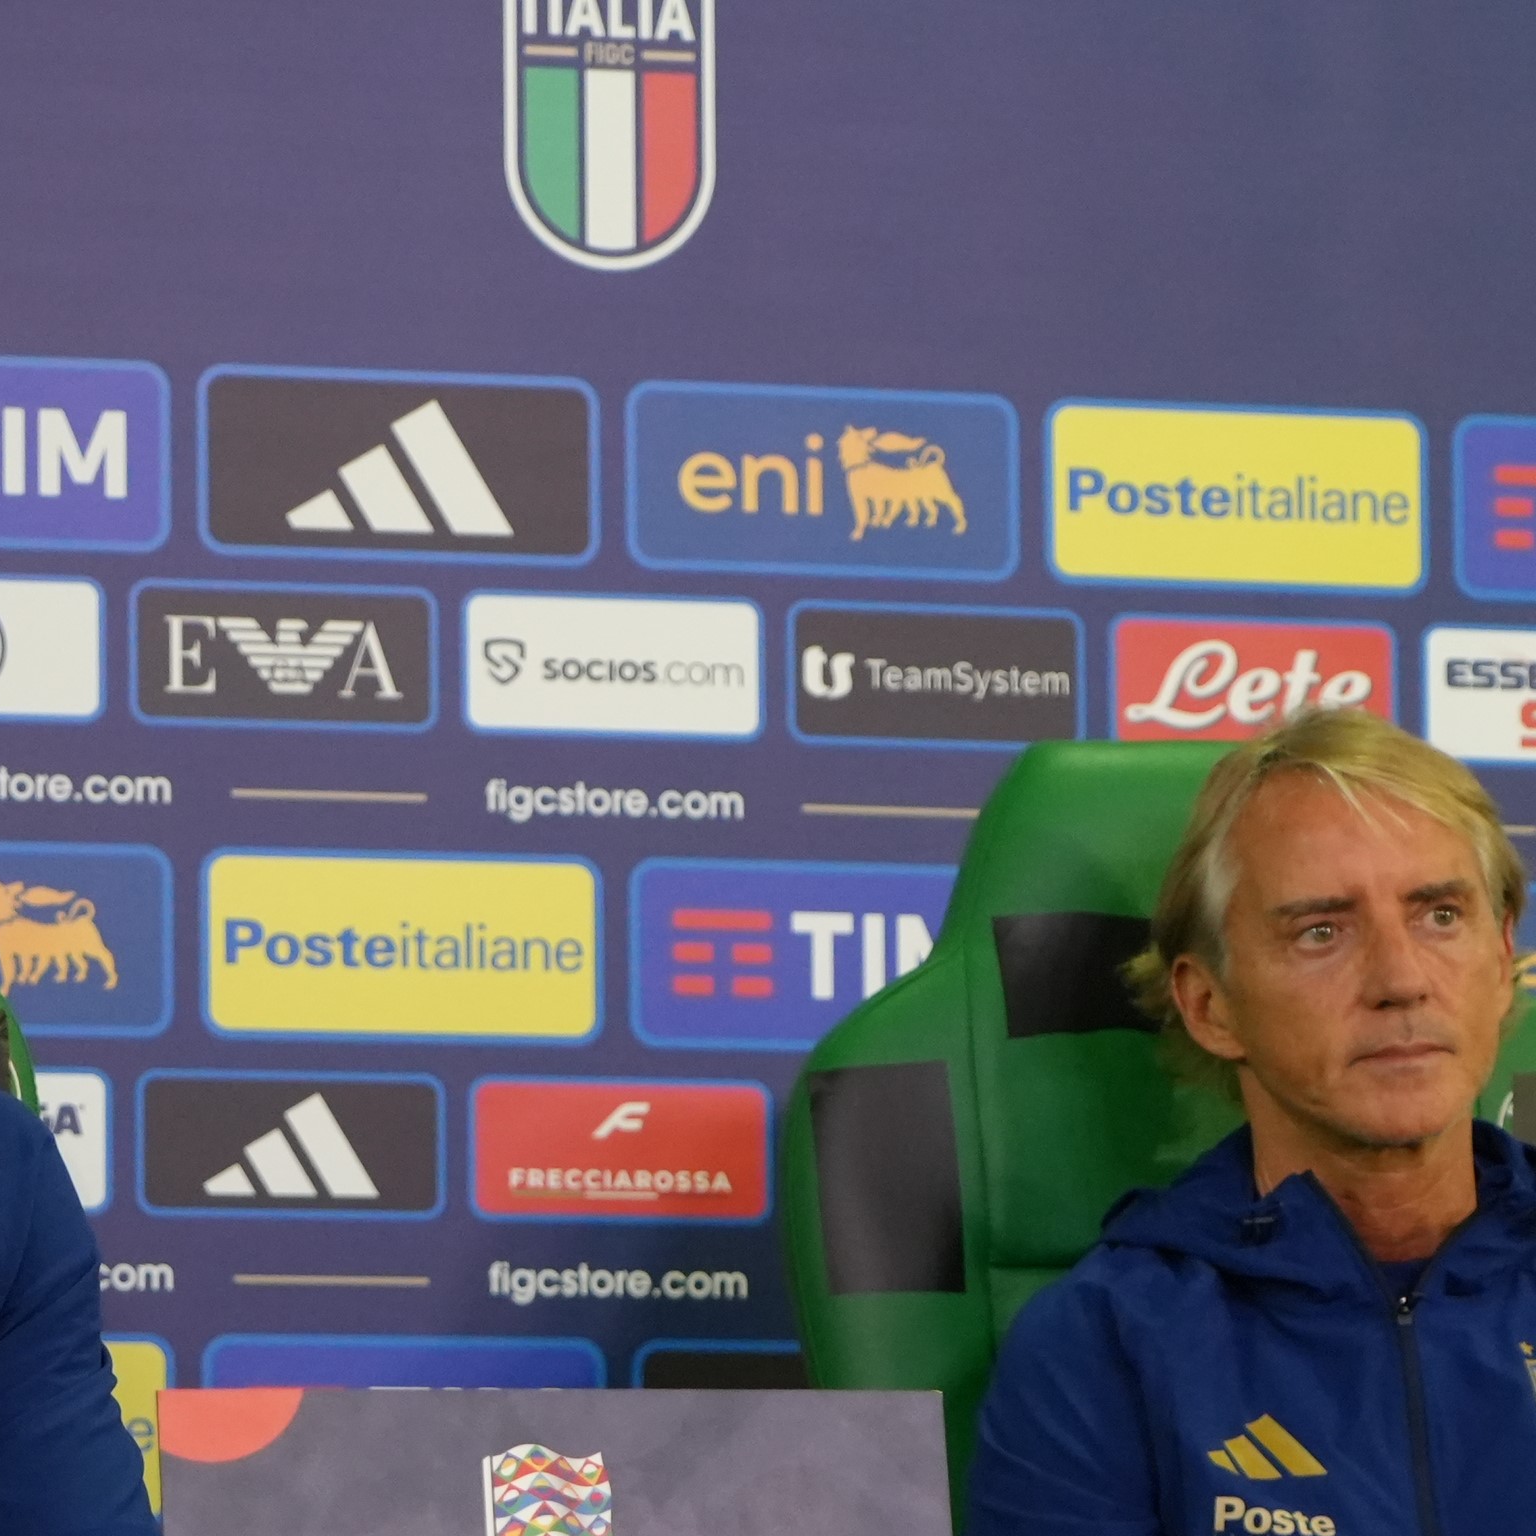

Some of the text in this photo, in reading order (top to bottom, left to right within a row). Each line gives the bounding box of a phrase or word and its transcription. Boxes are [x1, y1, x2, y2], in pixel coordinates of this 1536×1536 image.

[678, 433, 824, 516] eni
[1067, 467, 1410, 525] Posteitaliane
[864, 658, 1070, 700] TeamSystem
[485, 778, 745, 823] figcstore.com
[224, 918, 583, 972] Posteitaliane
[507, 1167, 732, 1193] FRECCIAROSSA
[487, 1260, 748, 1306] figcstore.com
